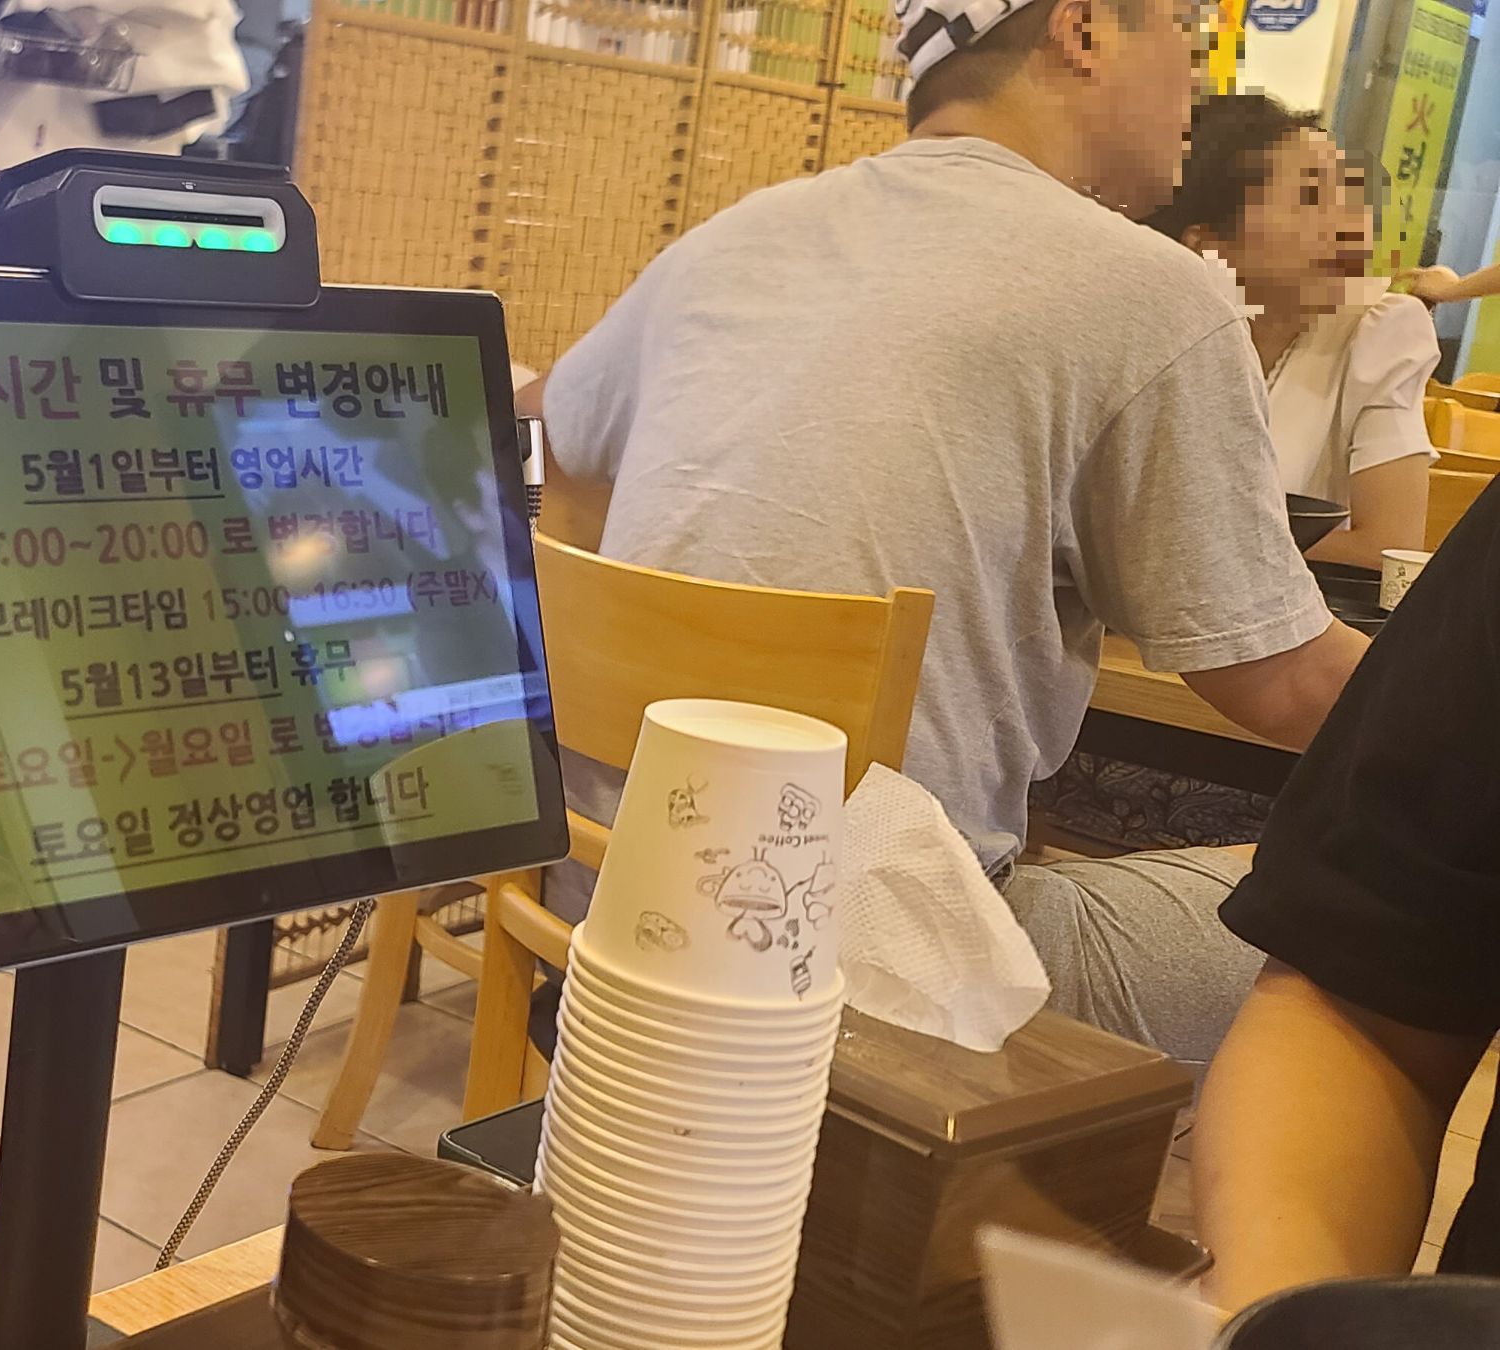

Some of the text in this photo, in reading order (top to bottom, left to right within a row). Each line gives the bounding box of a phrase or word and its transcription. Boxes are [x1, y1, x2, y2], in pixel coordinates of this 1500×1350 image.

[100, 356, 153, 420] 및
[166, 359, 264, 419] 휴무
[276, 359, 450, 420] 변경안내
[22, 444, 365, 495] 5월1일부터 영업시간
[221, 517, 259, 554] 로
[60, 640, 358, 708] 5월13일부터 휴무
[269, 714, 304, 756] 로
[31, 807, 156, 868] 토요일
[169, 780, 316, 850] 정상영업
[327, 766, 431, 824] 합니다
